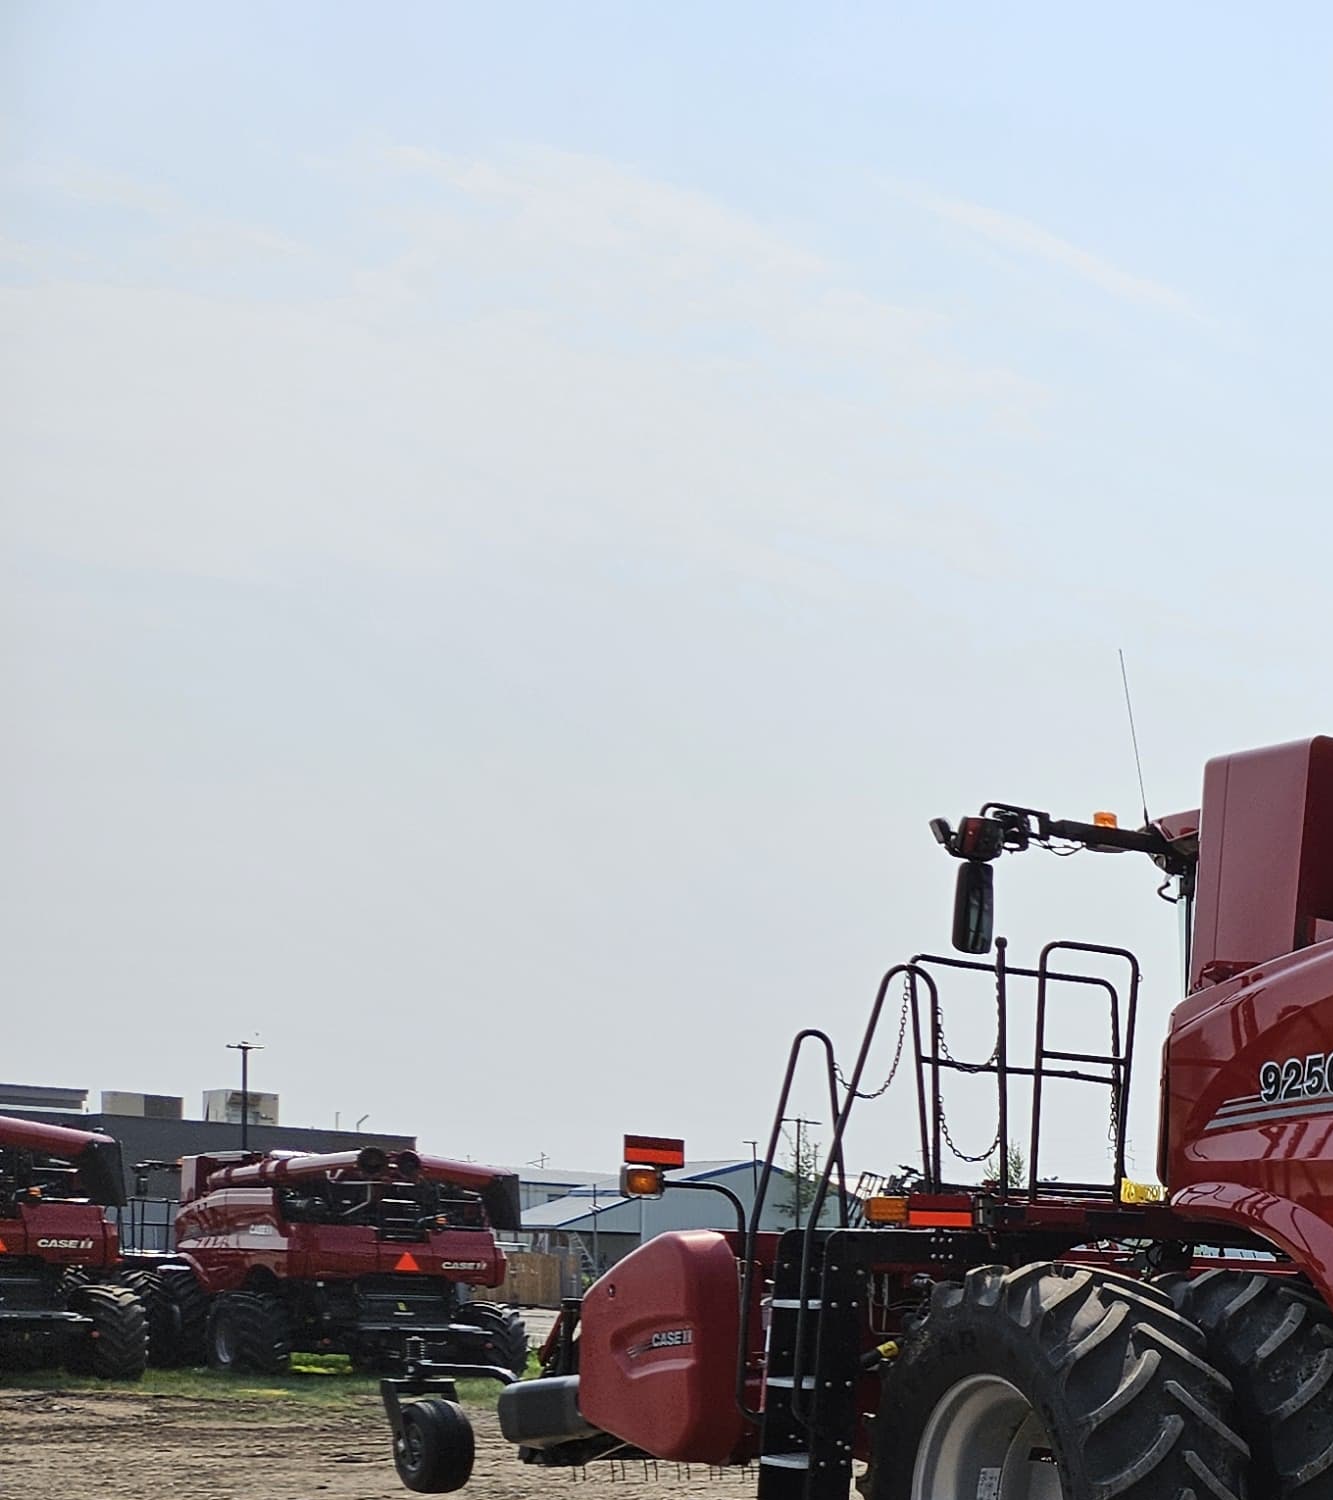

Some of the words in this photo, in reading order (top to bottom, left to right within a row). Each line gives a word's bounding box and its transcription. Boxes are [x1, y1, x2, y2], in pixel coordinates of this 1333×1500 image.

[37, 1239, 79, 1249] CASE
[442, 1261, 476, 1270] CASE
[652, 1331, 682, 1347] CASE
